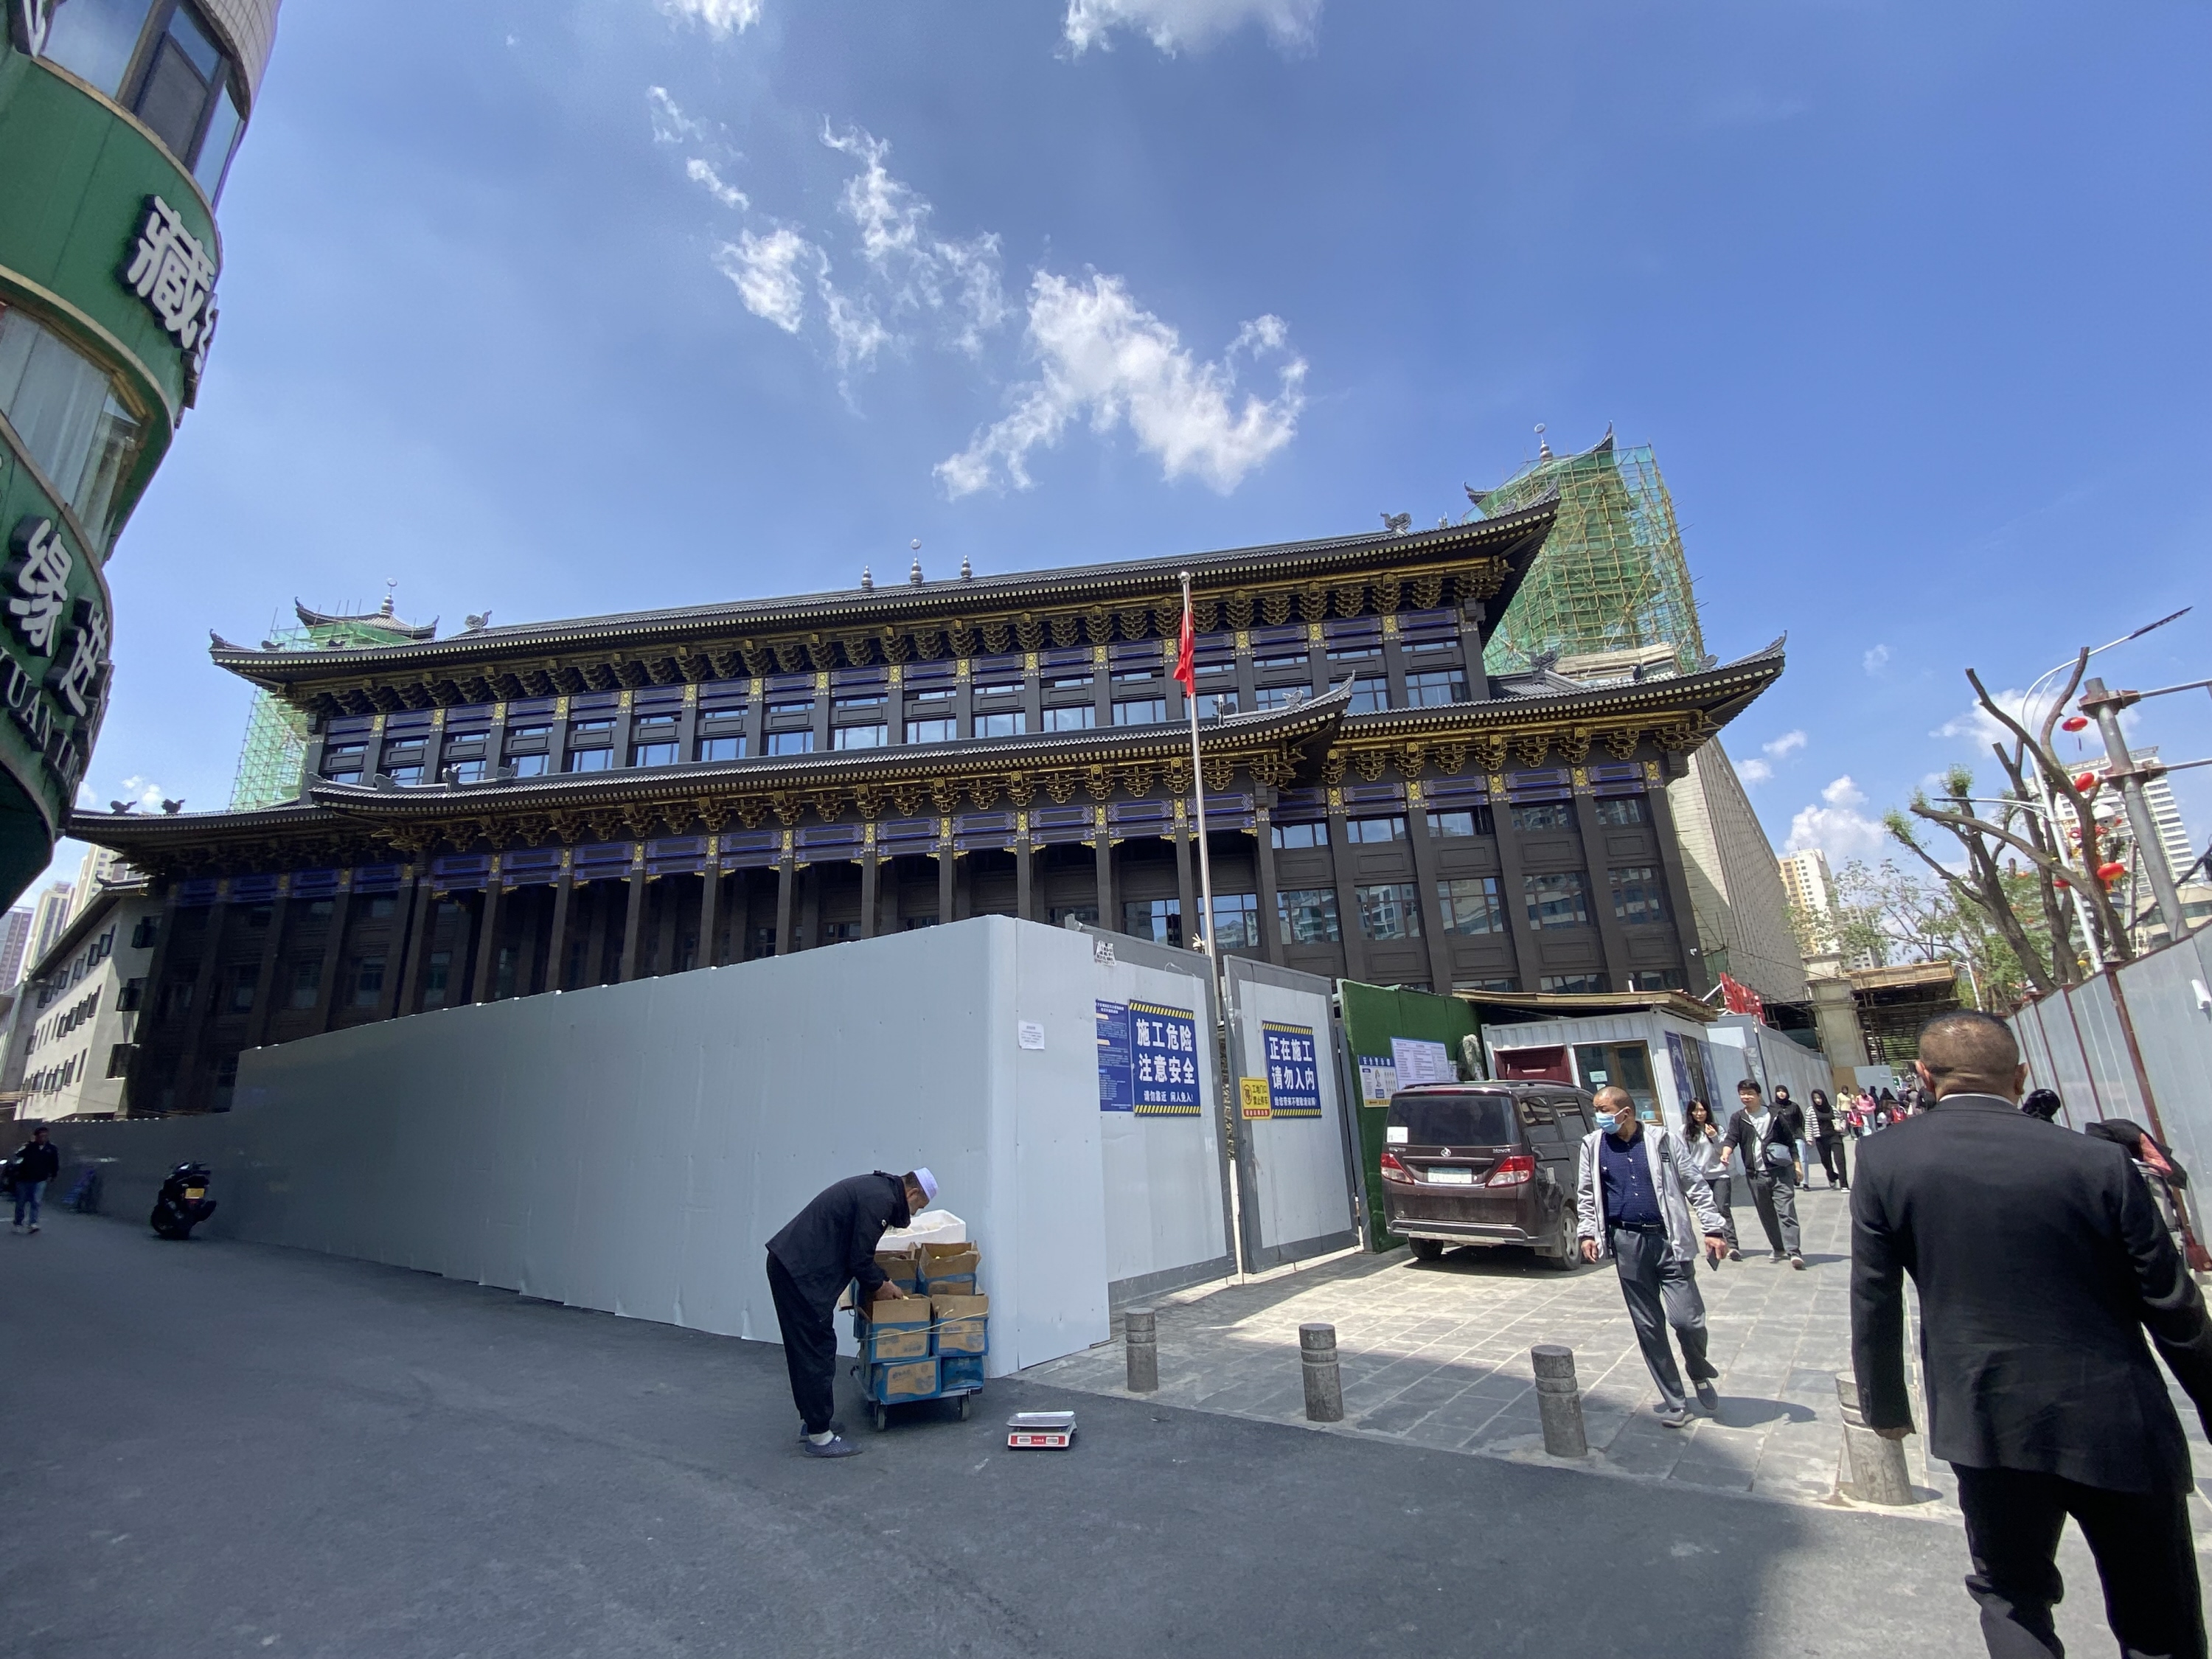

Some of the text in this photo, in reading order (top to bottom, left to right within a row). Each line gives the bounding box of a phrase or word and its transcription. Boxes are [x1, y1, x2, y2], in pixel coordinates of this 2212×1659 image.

[127, 195, 218, 374] 藏
[9, 518, 115, 759] 缘进
[1136, 1018, 1193, 1051] 施工危险
[1268, 1037, 1312, 1062] 正在施工
[1138, 1053, 1195, 1085] 注意安全
[1271, 1065, 1315, 1091] 请勿入内
